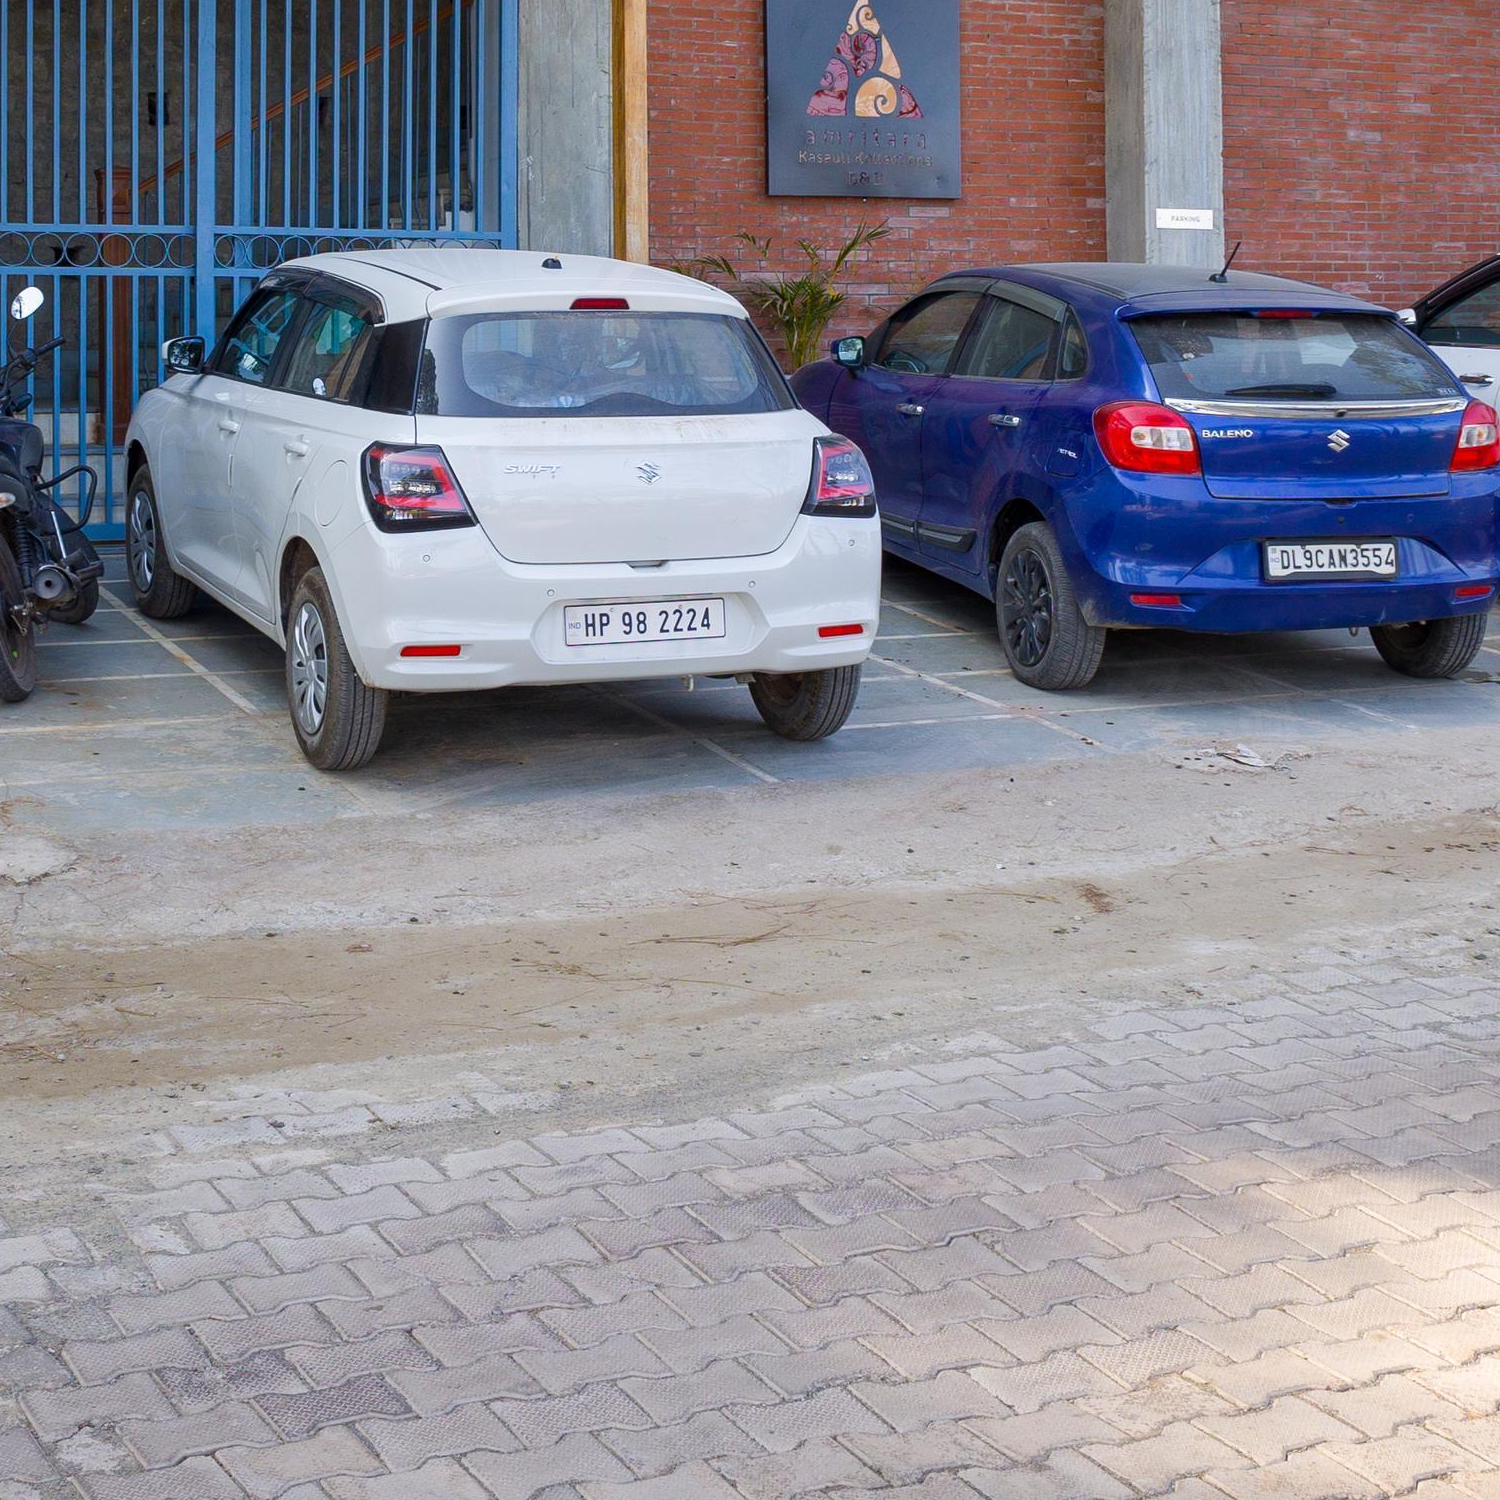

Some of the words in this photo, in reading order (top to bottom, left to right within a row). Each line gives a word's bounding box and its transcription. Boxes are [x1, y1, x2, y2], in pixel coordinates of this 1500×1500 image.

[798, 150, 851, 164] Kasauli
[1202, 429, 1253, 438] BALENO
[503, 464, 561, 475] SWIFT
[1280, 547, 1394, 570] DL9CAN3554
[584, 612, 610, 637] HP
[622, 611, 647, 635] 98
[658, 607, 711, 634] 2224
